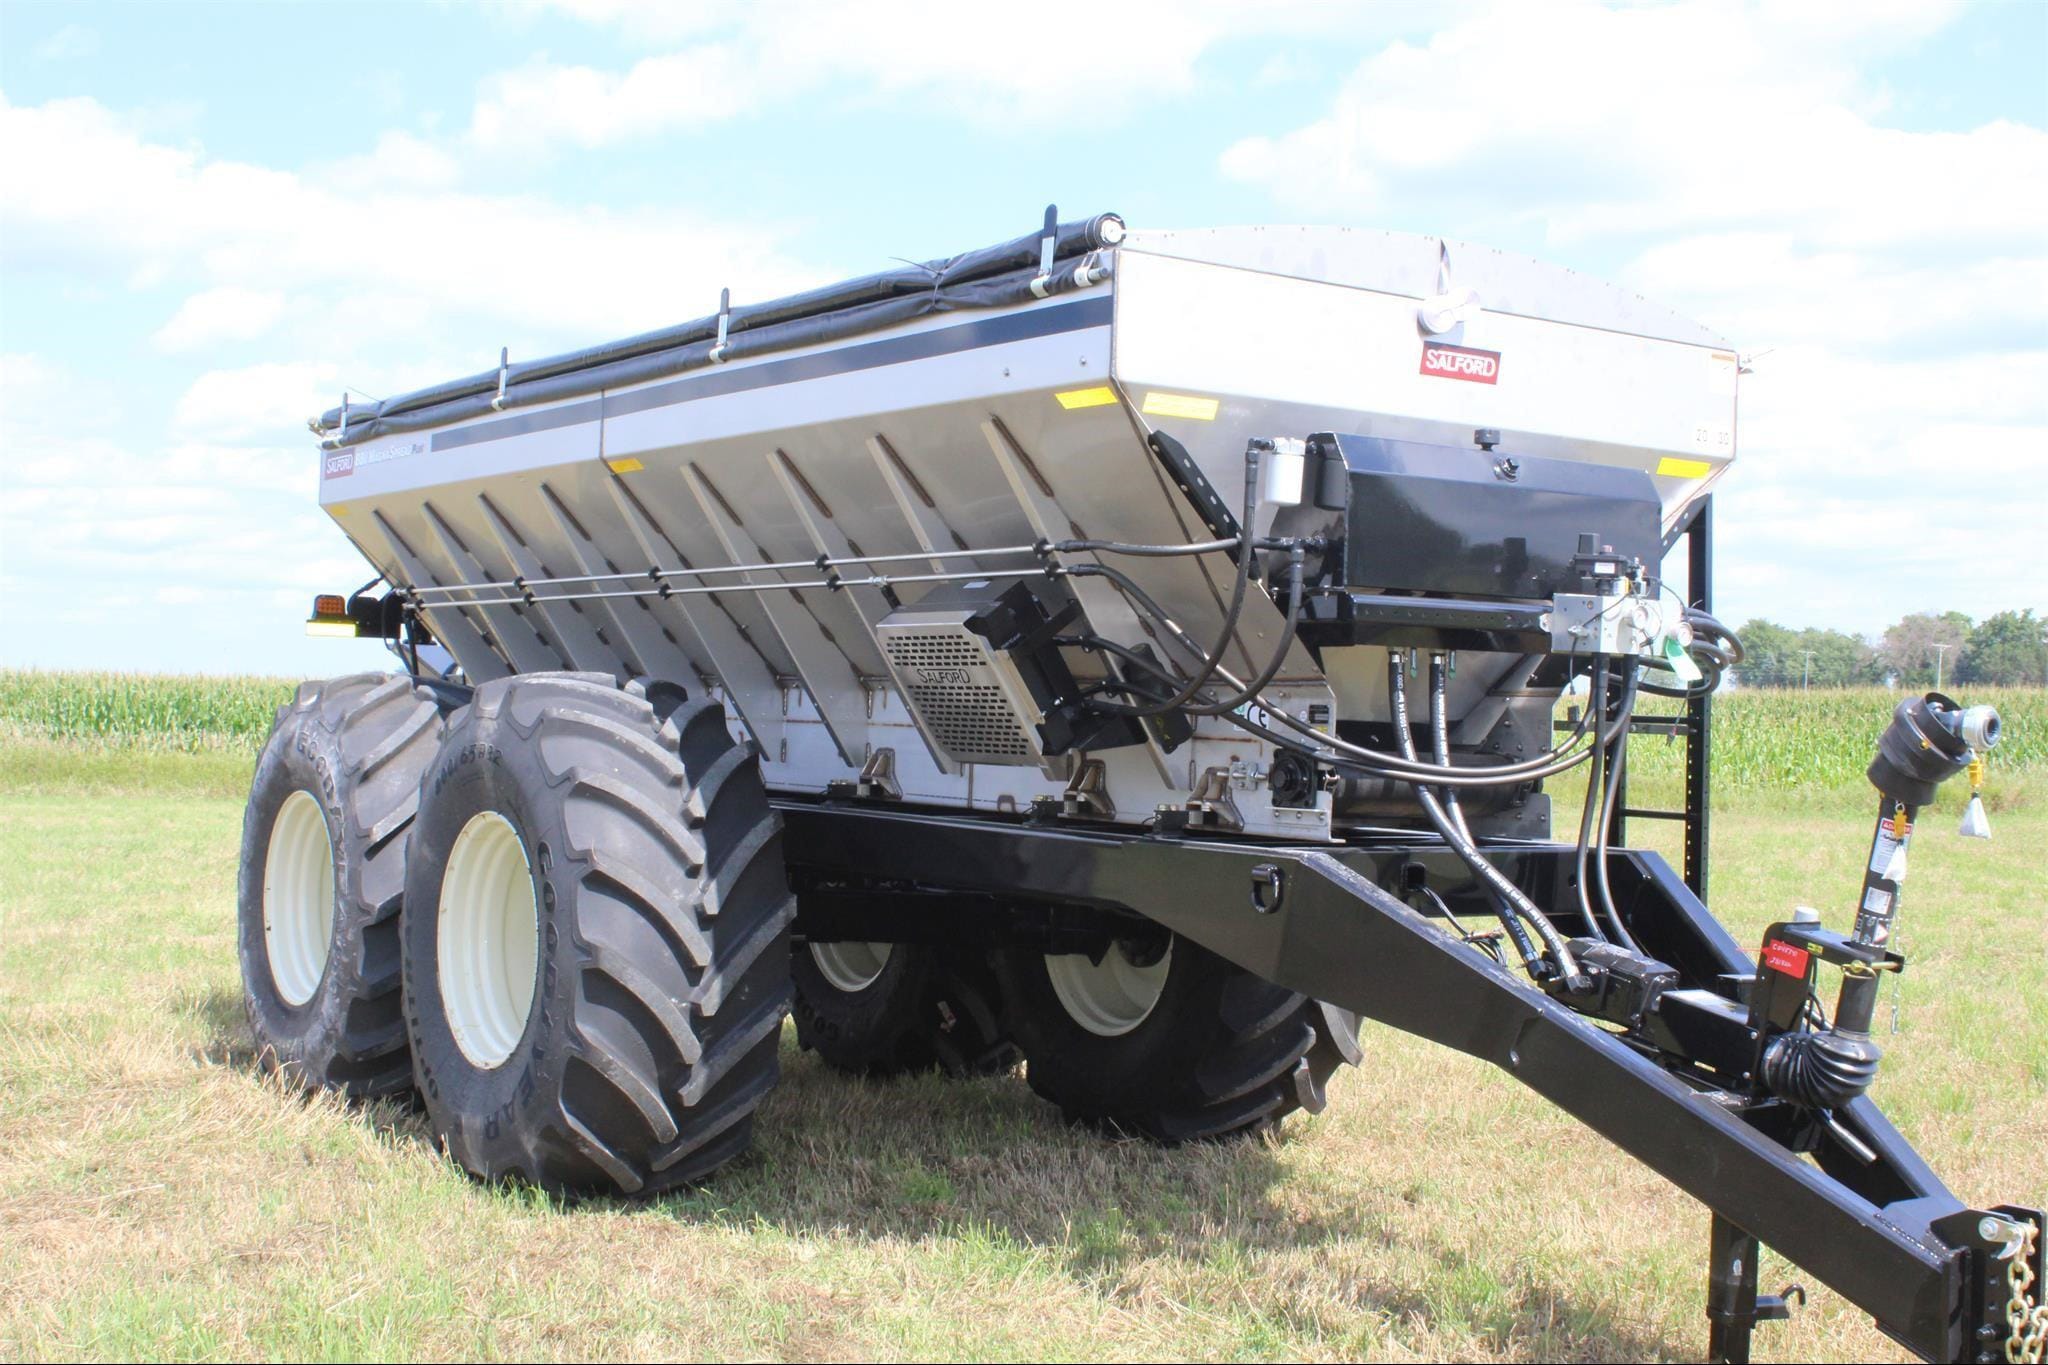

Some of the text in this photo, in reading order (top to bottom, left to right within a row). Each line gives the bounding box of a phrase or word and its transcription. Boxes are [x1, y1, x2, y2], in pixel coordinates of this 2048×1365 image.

[1425, 349, 1497, 378] SALFORD
[326, 454, 354, 474] SALFORD
[916, 668, 971, 684] SALFORD
